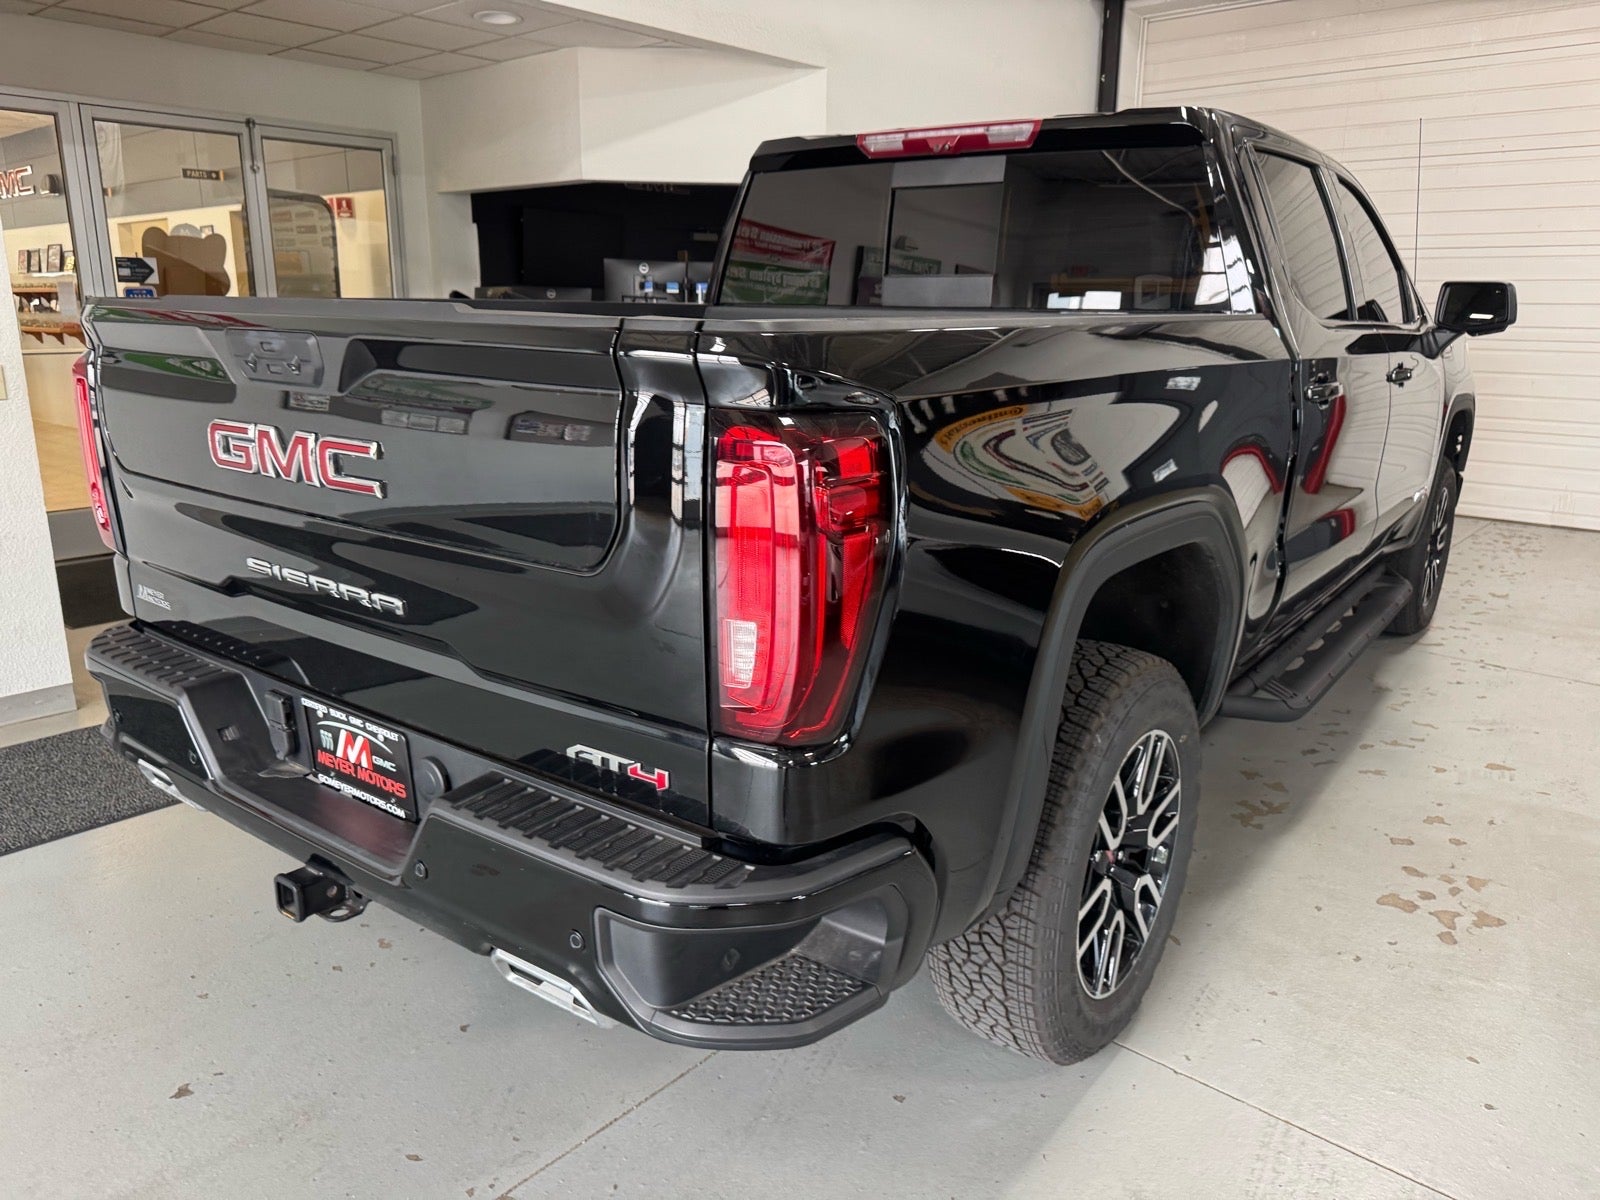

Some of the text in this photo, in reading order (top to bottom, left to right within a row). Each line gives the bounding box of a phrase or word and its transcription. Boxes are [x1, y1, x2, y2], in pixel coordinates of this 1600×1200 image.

[186, 170, 208, 179] PARTS
[207, 418, 387, 499] GMC
[246, 556, 406, 617] SIERRA
[365, 722, 399, 742] CHEVROLET
[317, 749, 406, 798] MEYER MOTORS
[372, 755, 397, 773] GMC
[566, 744, 669, 791] AT4
[318, 773, 406, 819] GOMEYERMOTORS.COM
